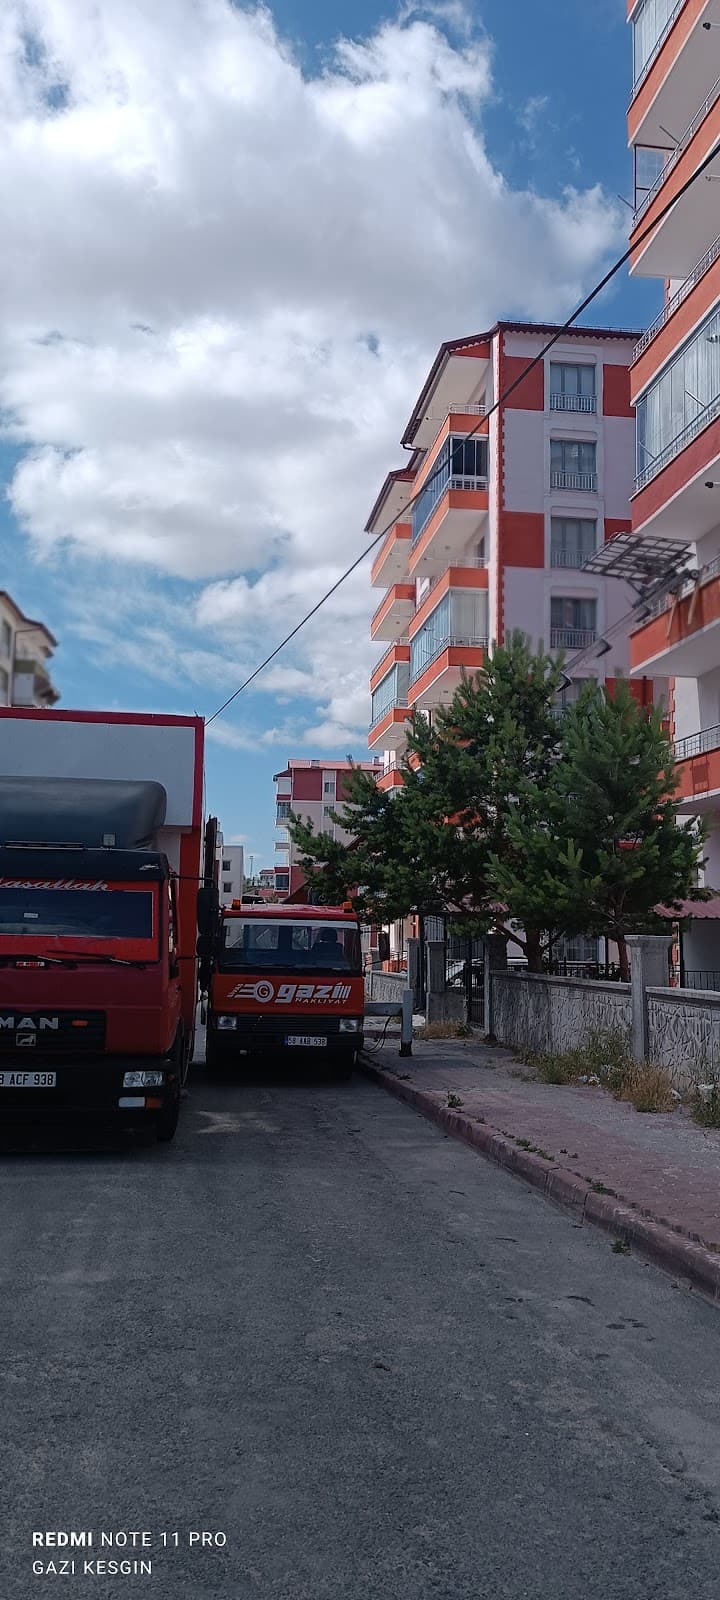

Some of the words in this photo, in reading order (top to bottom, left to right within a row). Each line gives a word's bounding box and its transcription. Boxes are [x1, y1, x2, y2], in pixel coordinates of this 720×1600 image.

[0, 1017, 59, 1030] MAN
[10, 1073, 29, 1086] ACF
[33, 1073, 54, 1086] 938
